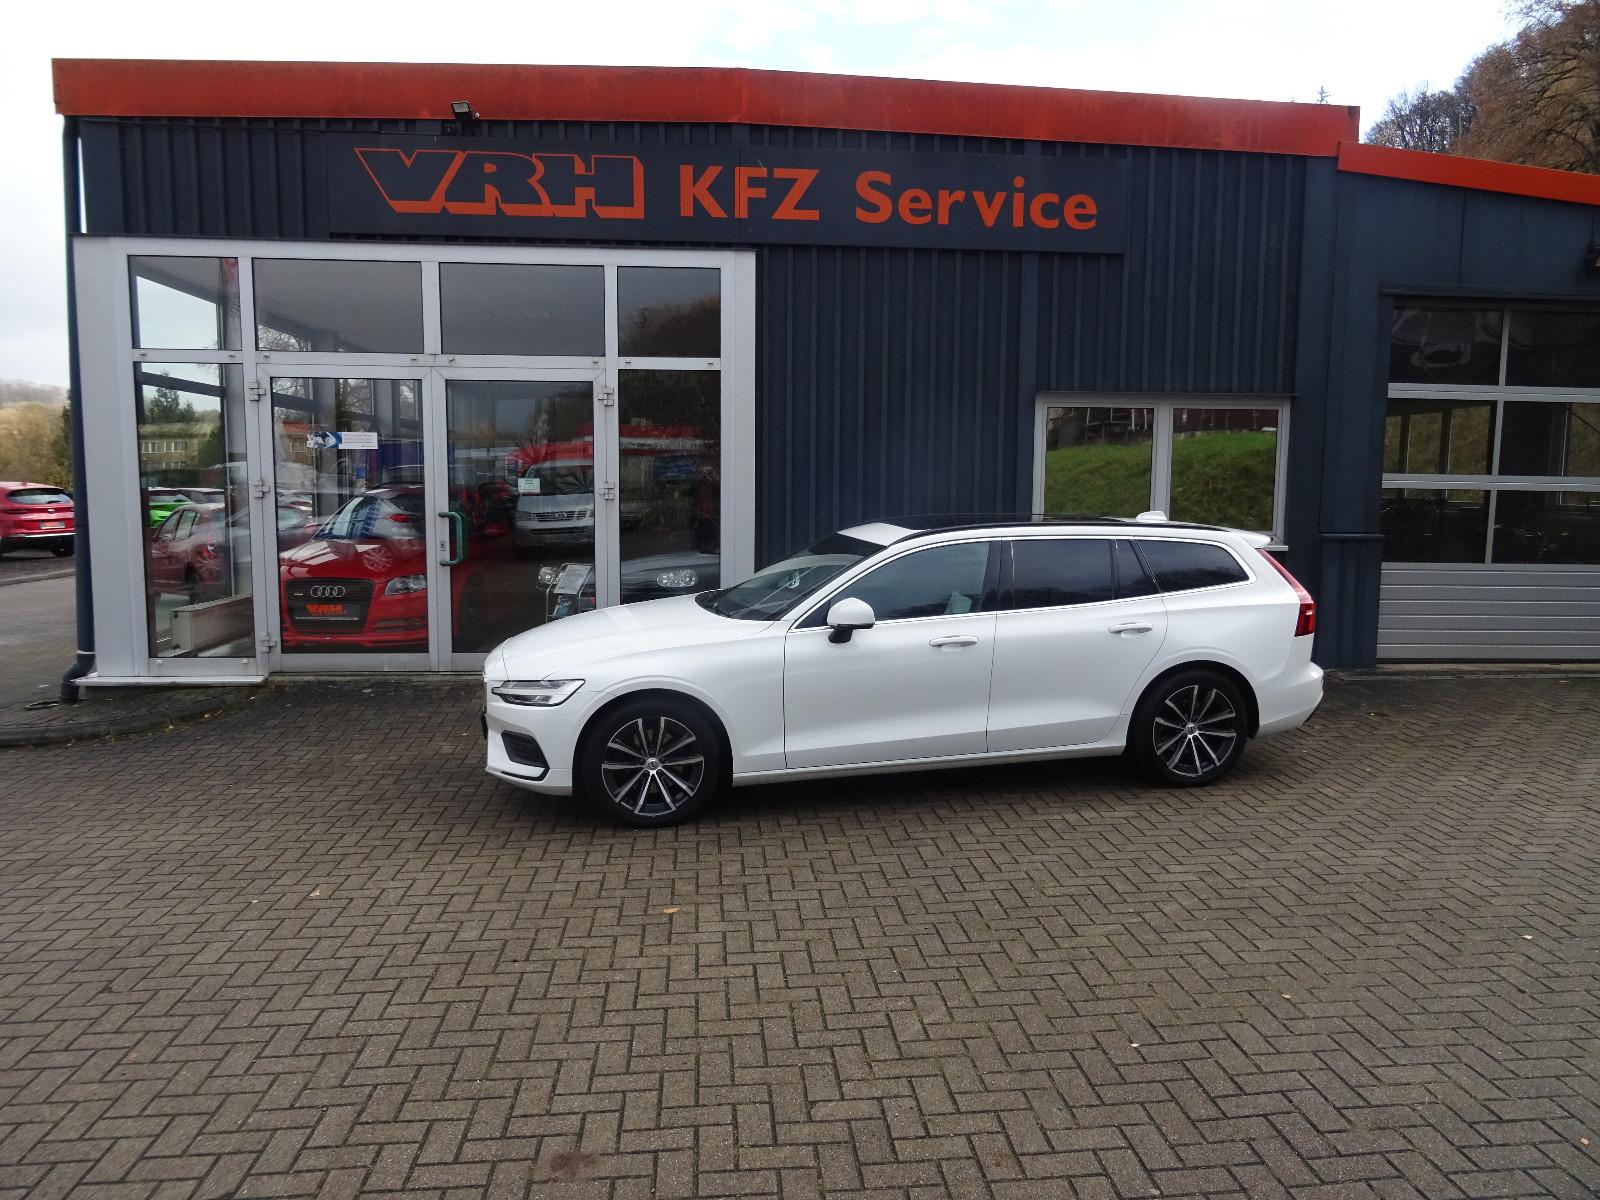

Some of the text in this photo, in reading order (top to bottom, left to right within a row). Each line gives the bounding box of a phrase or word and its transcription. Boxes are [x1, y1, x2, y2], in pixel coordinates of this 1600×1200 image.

[354, 148, 1098, 230] VRH KFZ Service
